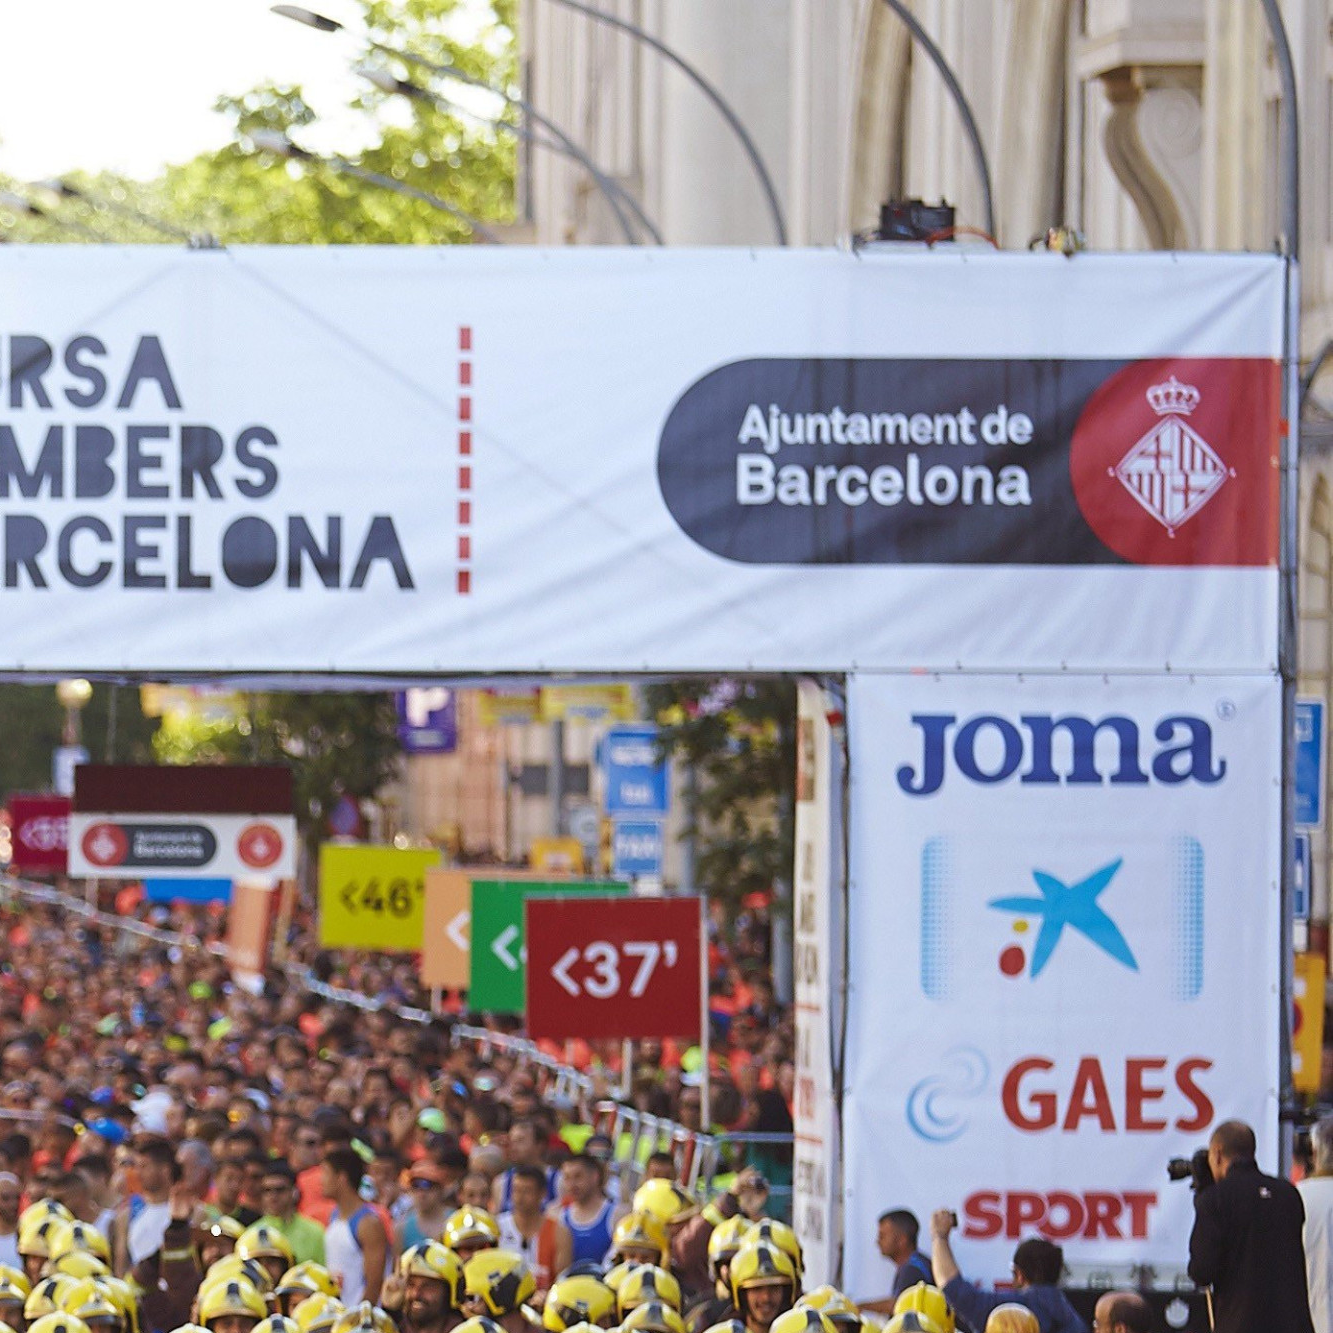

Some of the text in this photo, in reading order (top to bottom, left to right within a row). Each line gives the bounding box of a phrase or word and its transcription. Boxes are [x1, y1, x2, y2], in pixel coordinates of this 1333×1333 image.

[738, 404, 1033, 454] Ajuntament de
[737, 454, 1032, 507] Barcelona
[550, 940, 678, 999] <37'
[1000, 1056, 1215, 1134] GAES
[964, 1190, 1159, 1242] SPORT
